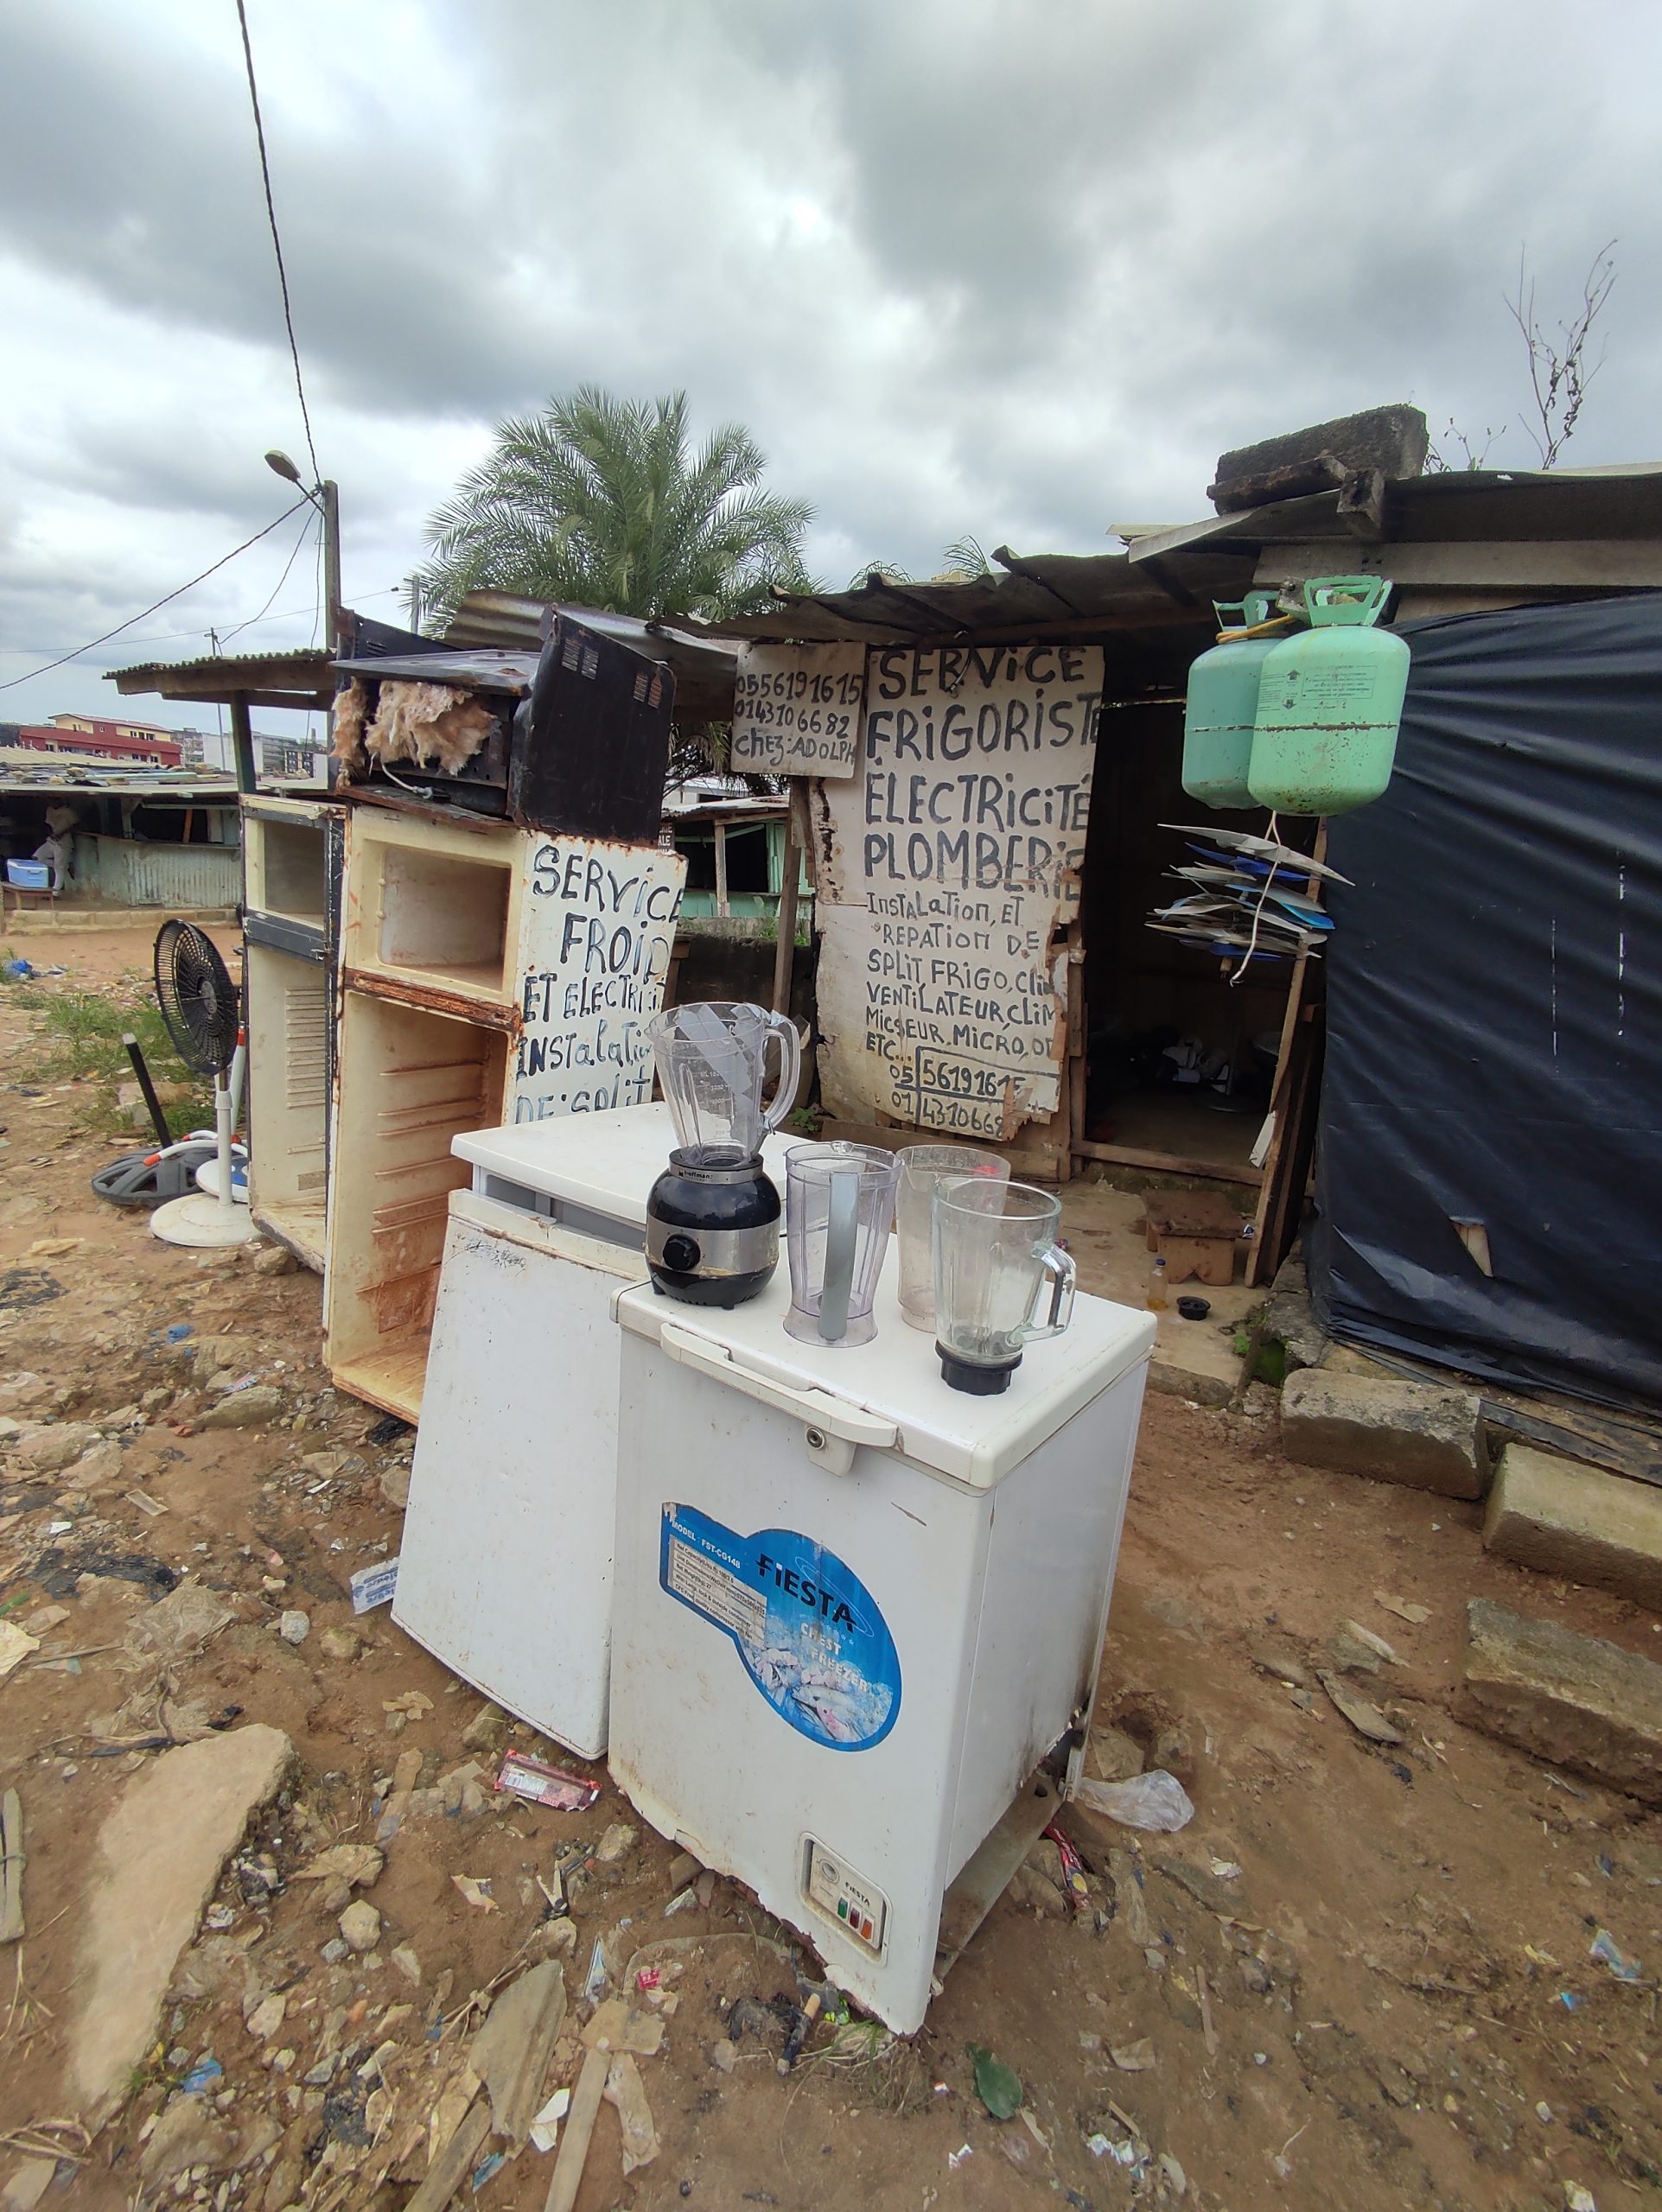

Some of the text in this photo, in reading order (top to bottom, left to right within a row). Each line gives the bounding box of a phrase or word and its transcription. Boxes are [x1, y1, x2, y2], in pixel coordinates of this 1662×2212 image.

[1001, 896, 1024, 926] ET
[1007, 930, 1040, 956] DE
[523, 973, 557, 1023] ET
[889, 1064, 914, 1084] 05
[891, 1091, 914, 1116] 01
[671, 1521, 697, 1541] MODEL
